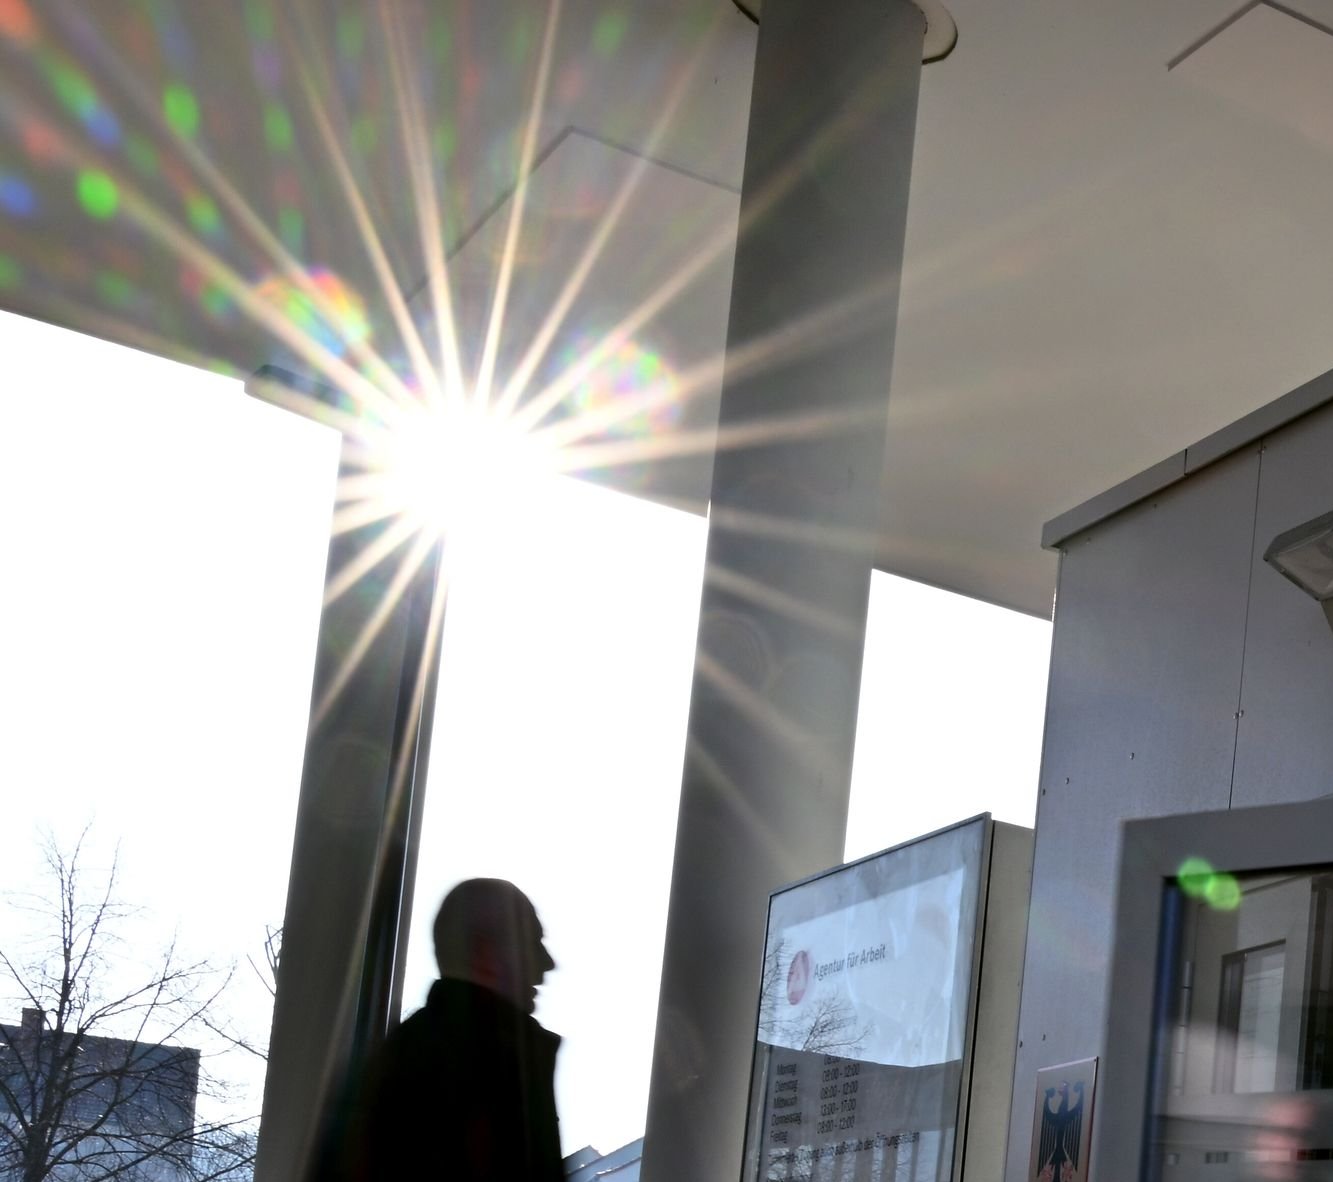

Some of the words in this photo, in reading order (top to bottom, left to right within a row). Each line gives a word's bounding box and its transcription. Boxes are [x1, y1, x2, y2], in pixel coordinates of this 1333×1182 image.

[813, 959, 845, 981] Agentur
[847, 954, 859, 969] für
[860, 944, 886, 965] Arbeit
